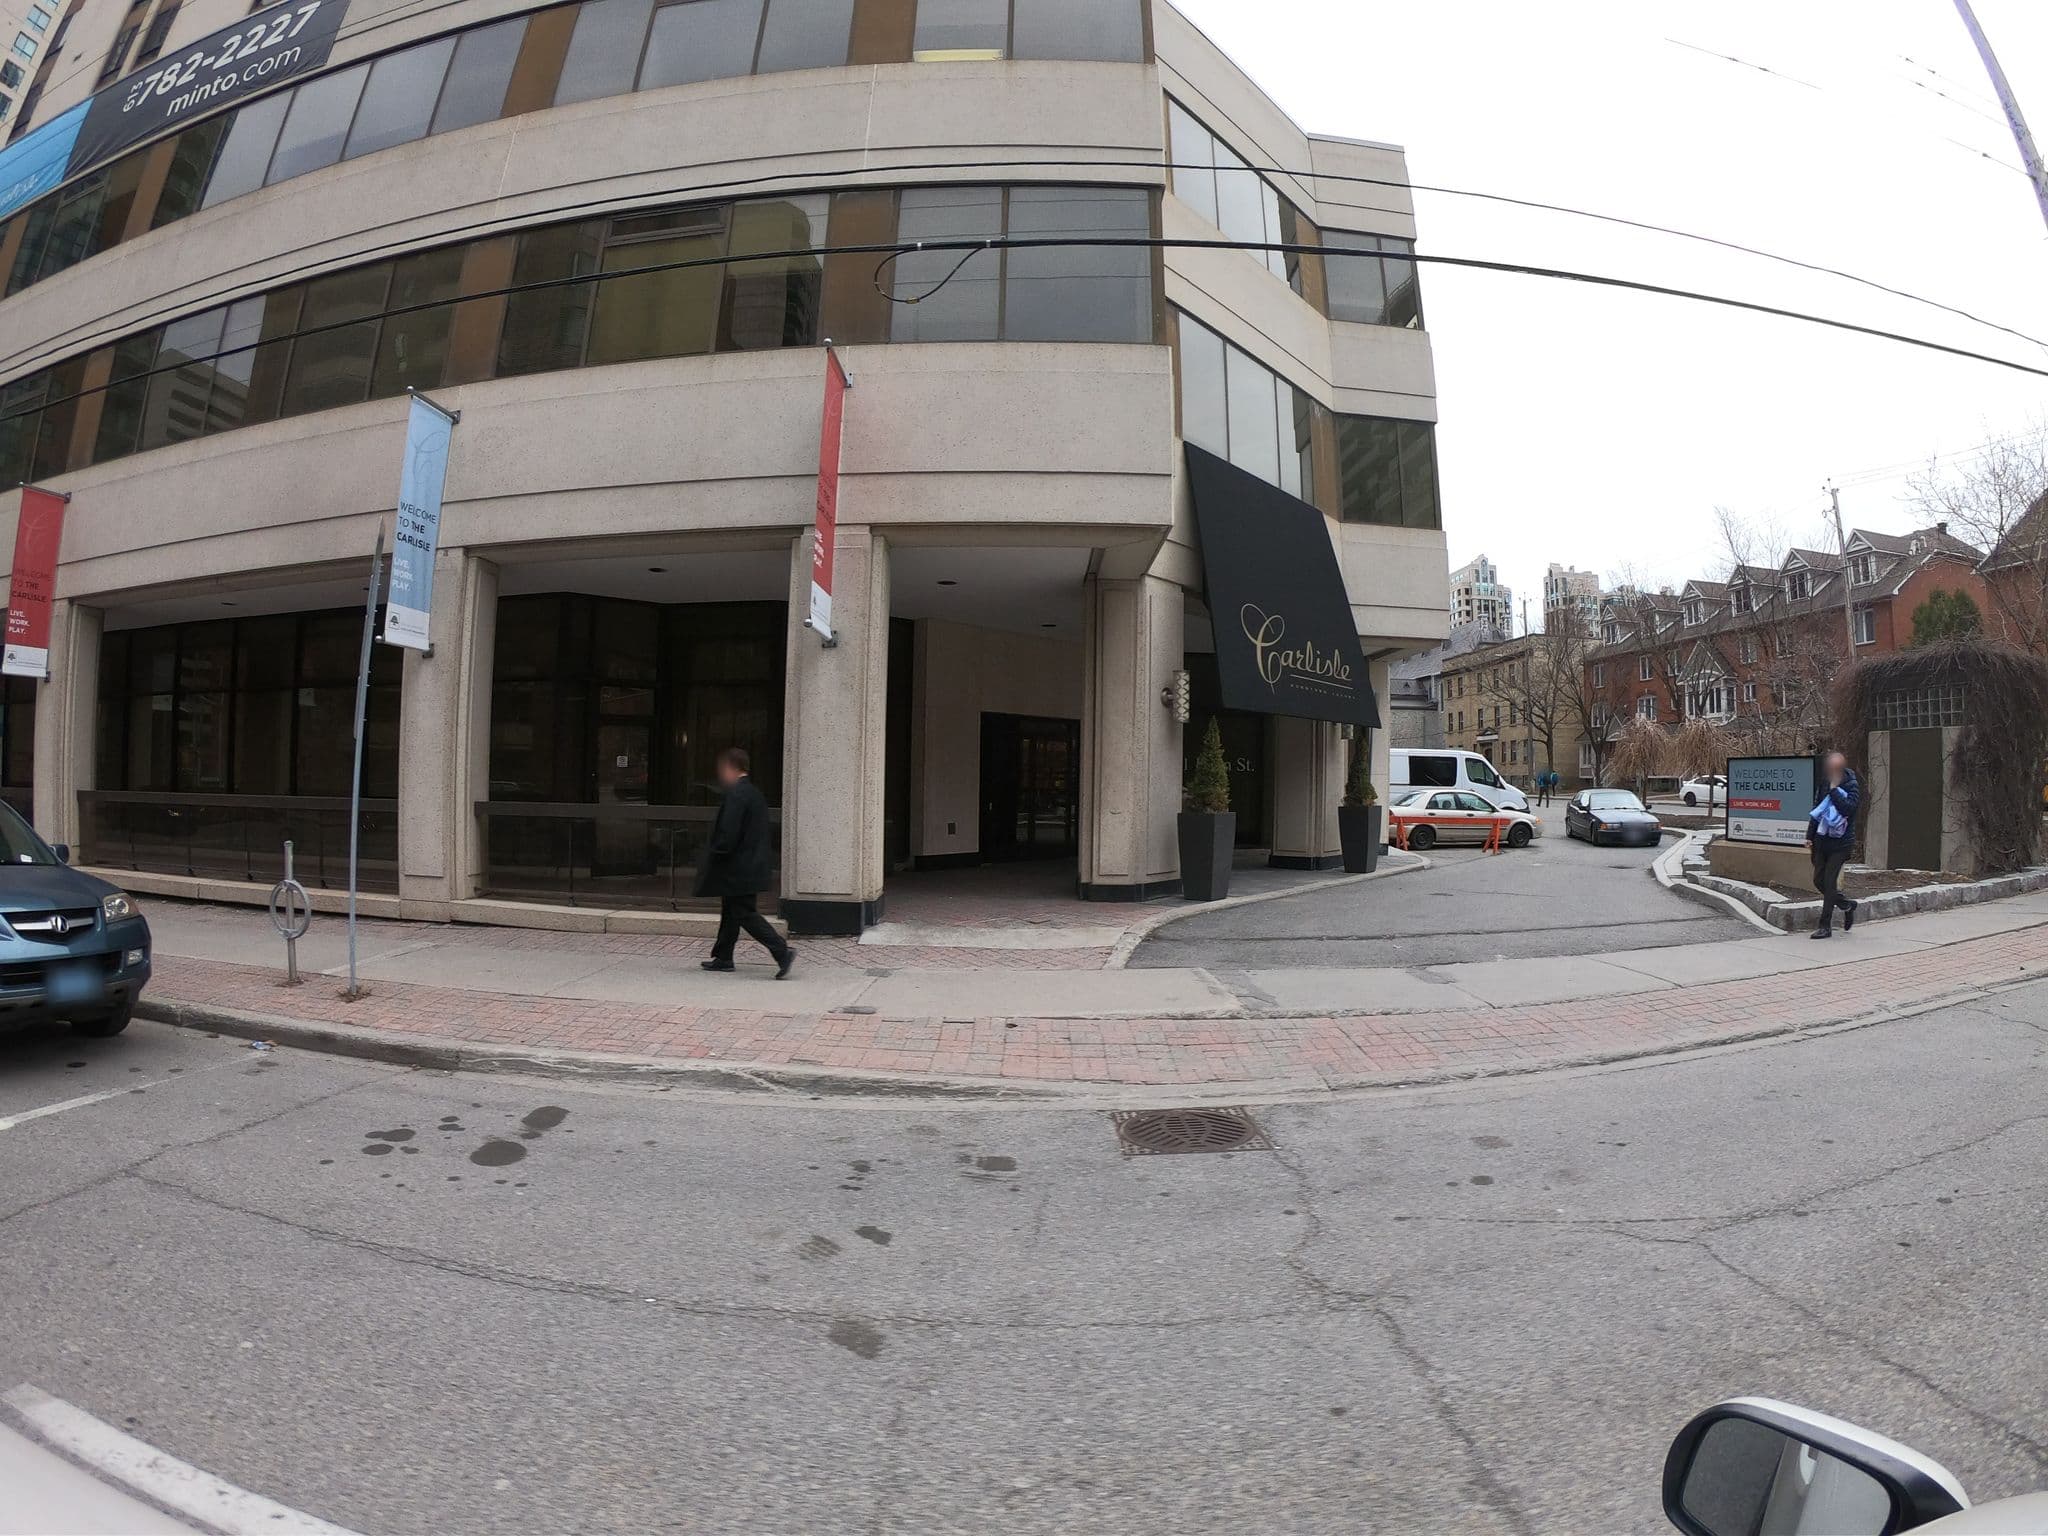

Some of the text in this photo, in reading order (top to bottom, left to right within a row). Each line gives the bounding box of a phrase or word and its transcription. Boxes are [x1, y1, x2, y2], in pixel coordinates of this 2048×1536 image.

[123, 1, 321, 113] 613 782-2227
[167, 45, 302, 117] minto.com
[400, 500, 437, 524] WELCOME
[399, 516, 426, 534] TO THE
[396, 531, 431, 552] CARLISLE
[25, 581, 40, 590] THE
[12, 590, 47, 603] CARLISLE
[1240, 603, 1353, 695] Carlisle
[1735, 769, 1794, 779] WELCOME TO
[1734, 782, 1796, 791] THE CARLISLE
